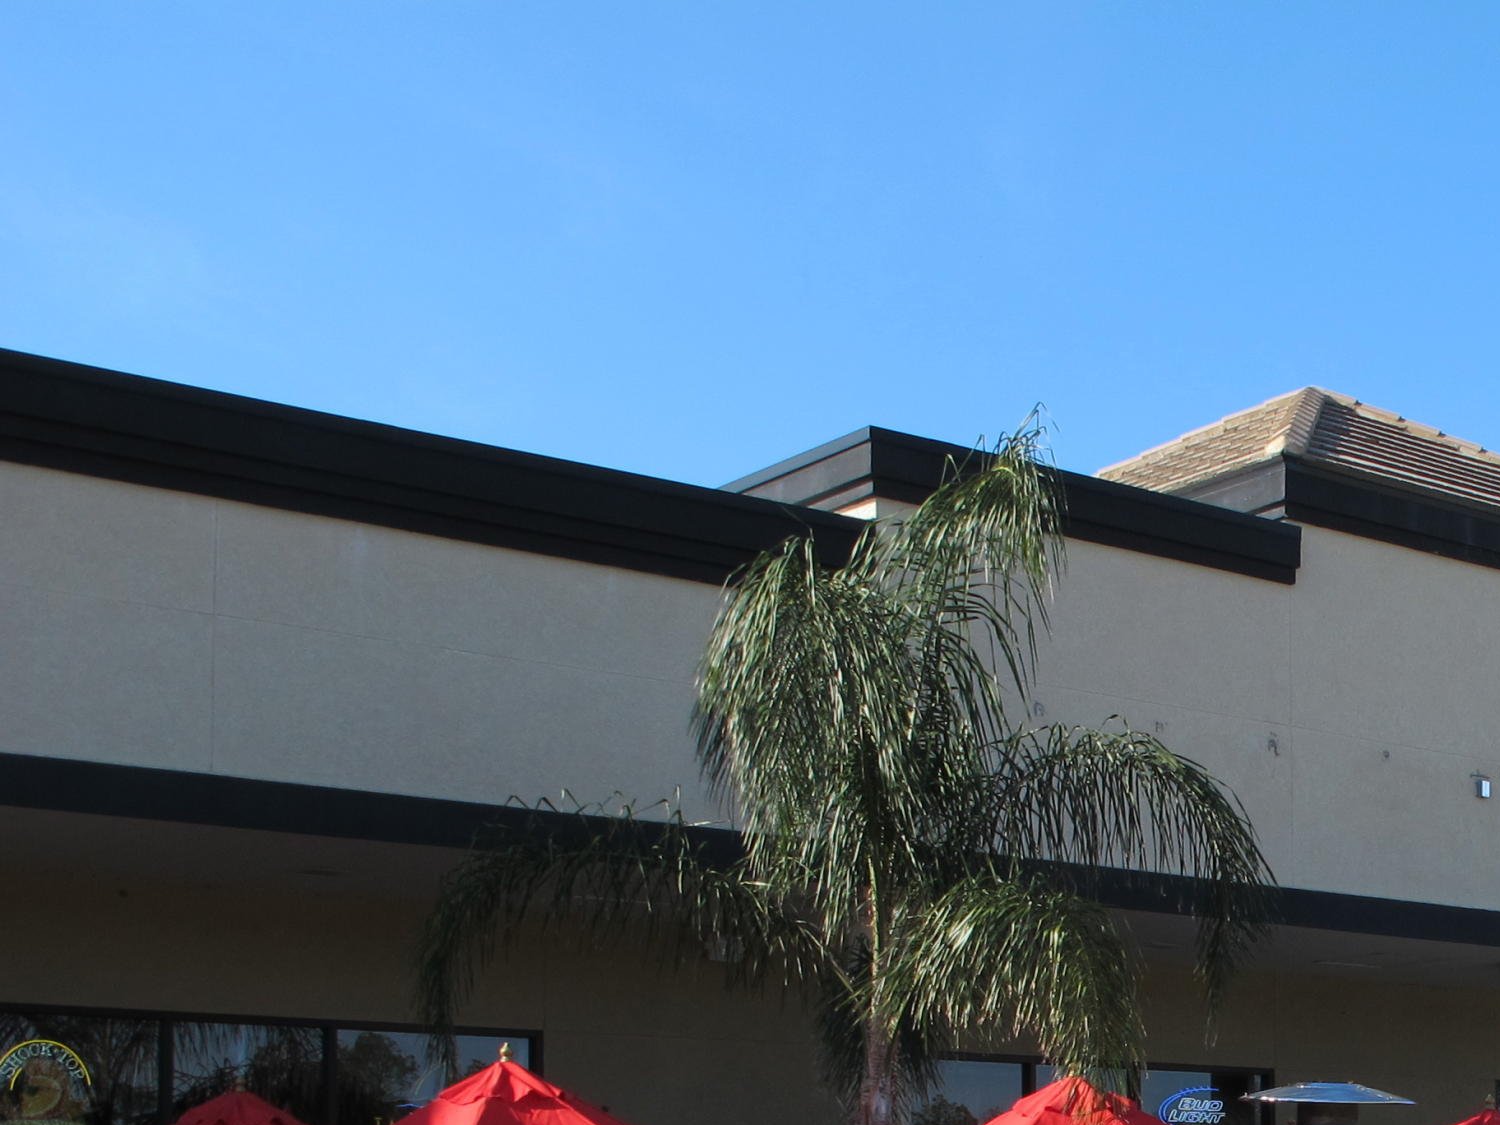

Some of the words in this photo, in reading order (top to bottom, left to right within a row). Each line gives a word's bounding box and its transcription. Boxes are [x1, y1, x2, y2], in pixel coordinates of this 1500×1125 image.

[56, 1048, 85, 1079] TOP
[1178, 1097, 1223, 1111] BUD
[1167, 1109, 1226, 1123] LIGHT
